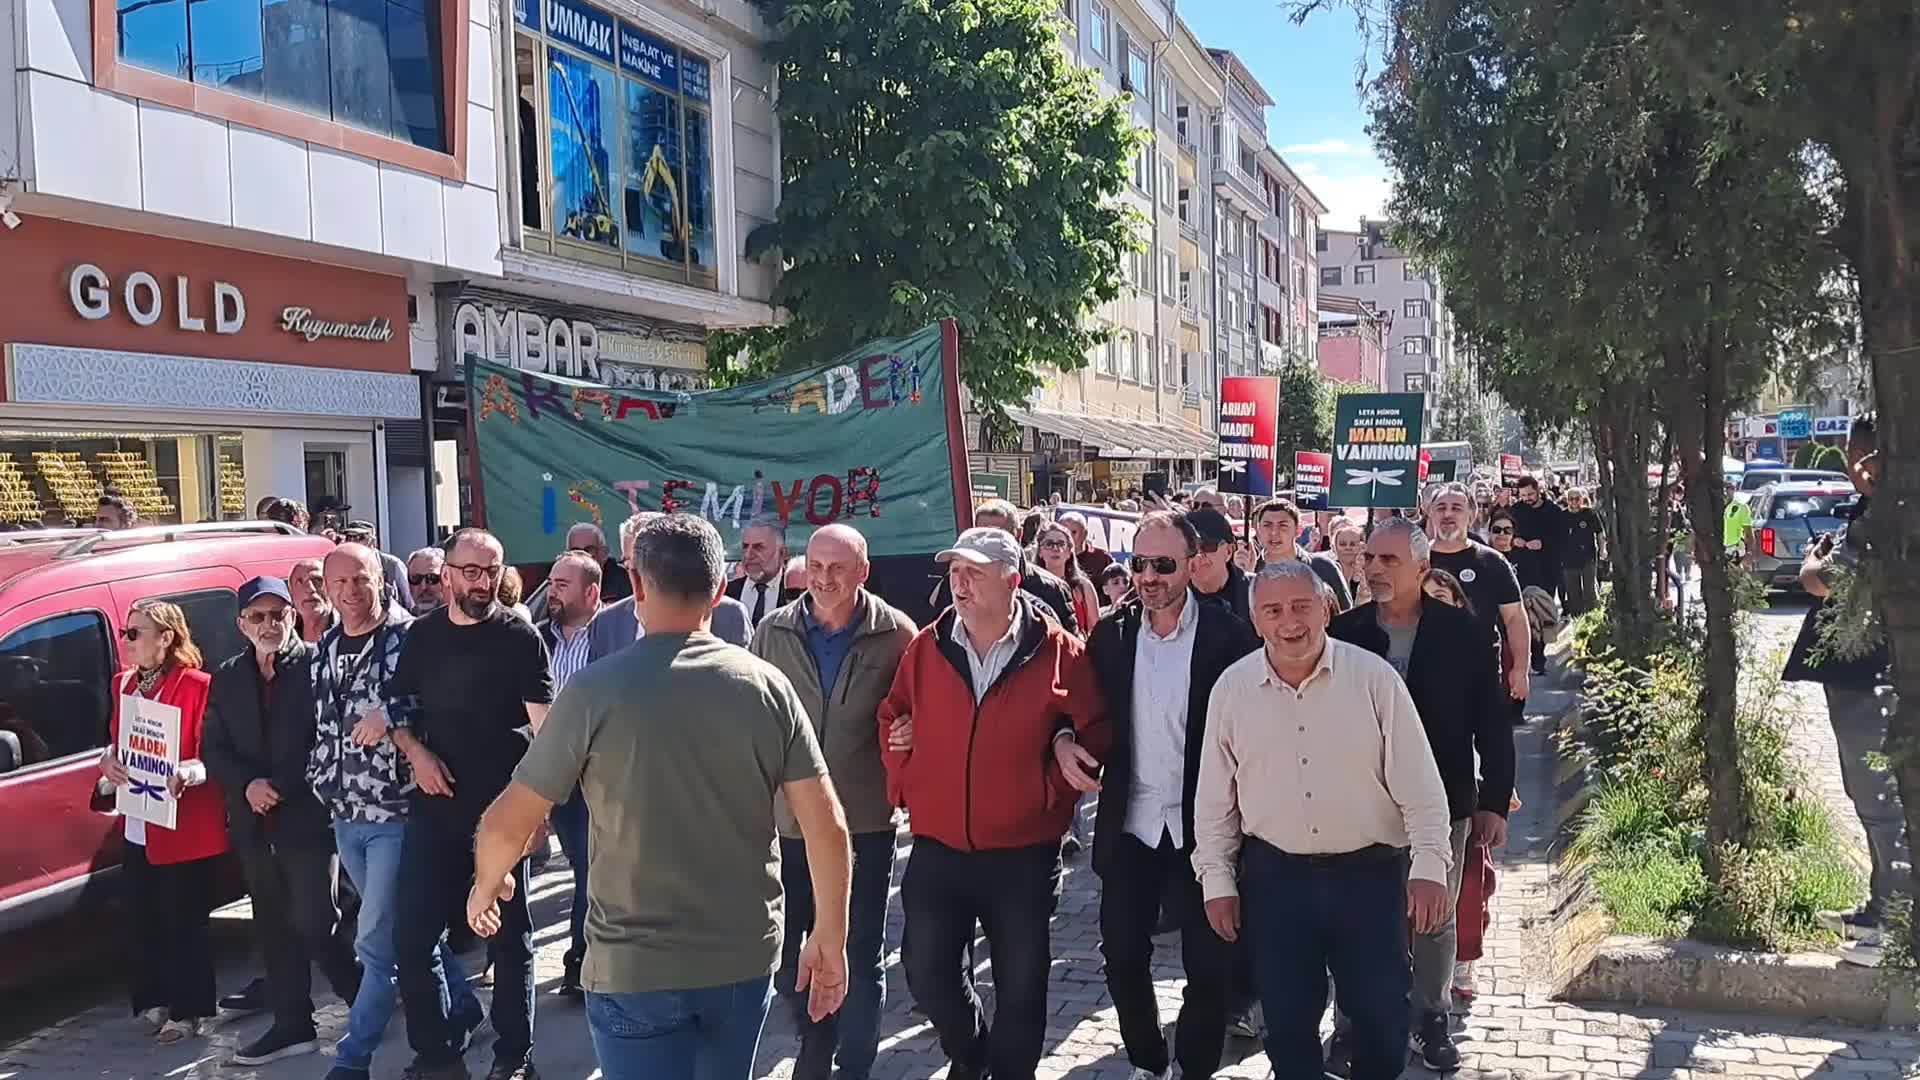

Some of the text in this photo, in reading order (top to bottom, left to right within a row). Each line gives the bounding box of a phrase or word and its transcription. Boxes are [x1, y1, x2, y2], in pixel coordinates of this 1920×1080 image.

[660, 50, 675, 68] VE
[70, 263, 246, 334] GOLD
[280, 306, 394, 342] Kuyumculuk
[455, 303, 600, 379] AMBAR
[1220, 422, 1254, 437] MADEN
[1375, 417, 1403, 426] MİNON
[1348, 427, 1407, 443] MADEN
[542, 466, 880, 536] İSTEMİYOR
[129, 734, 167, 758] MADEN
